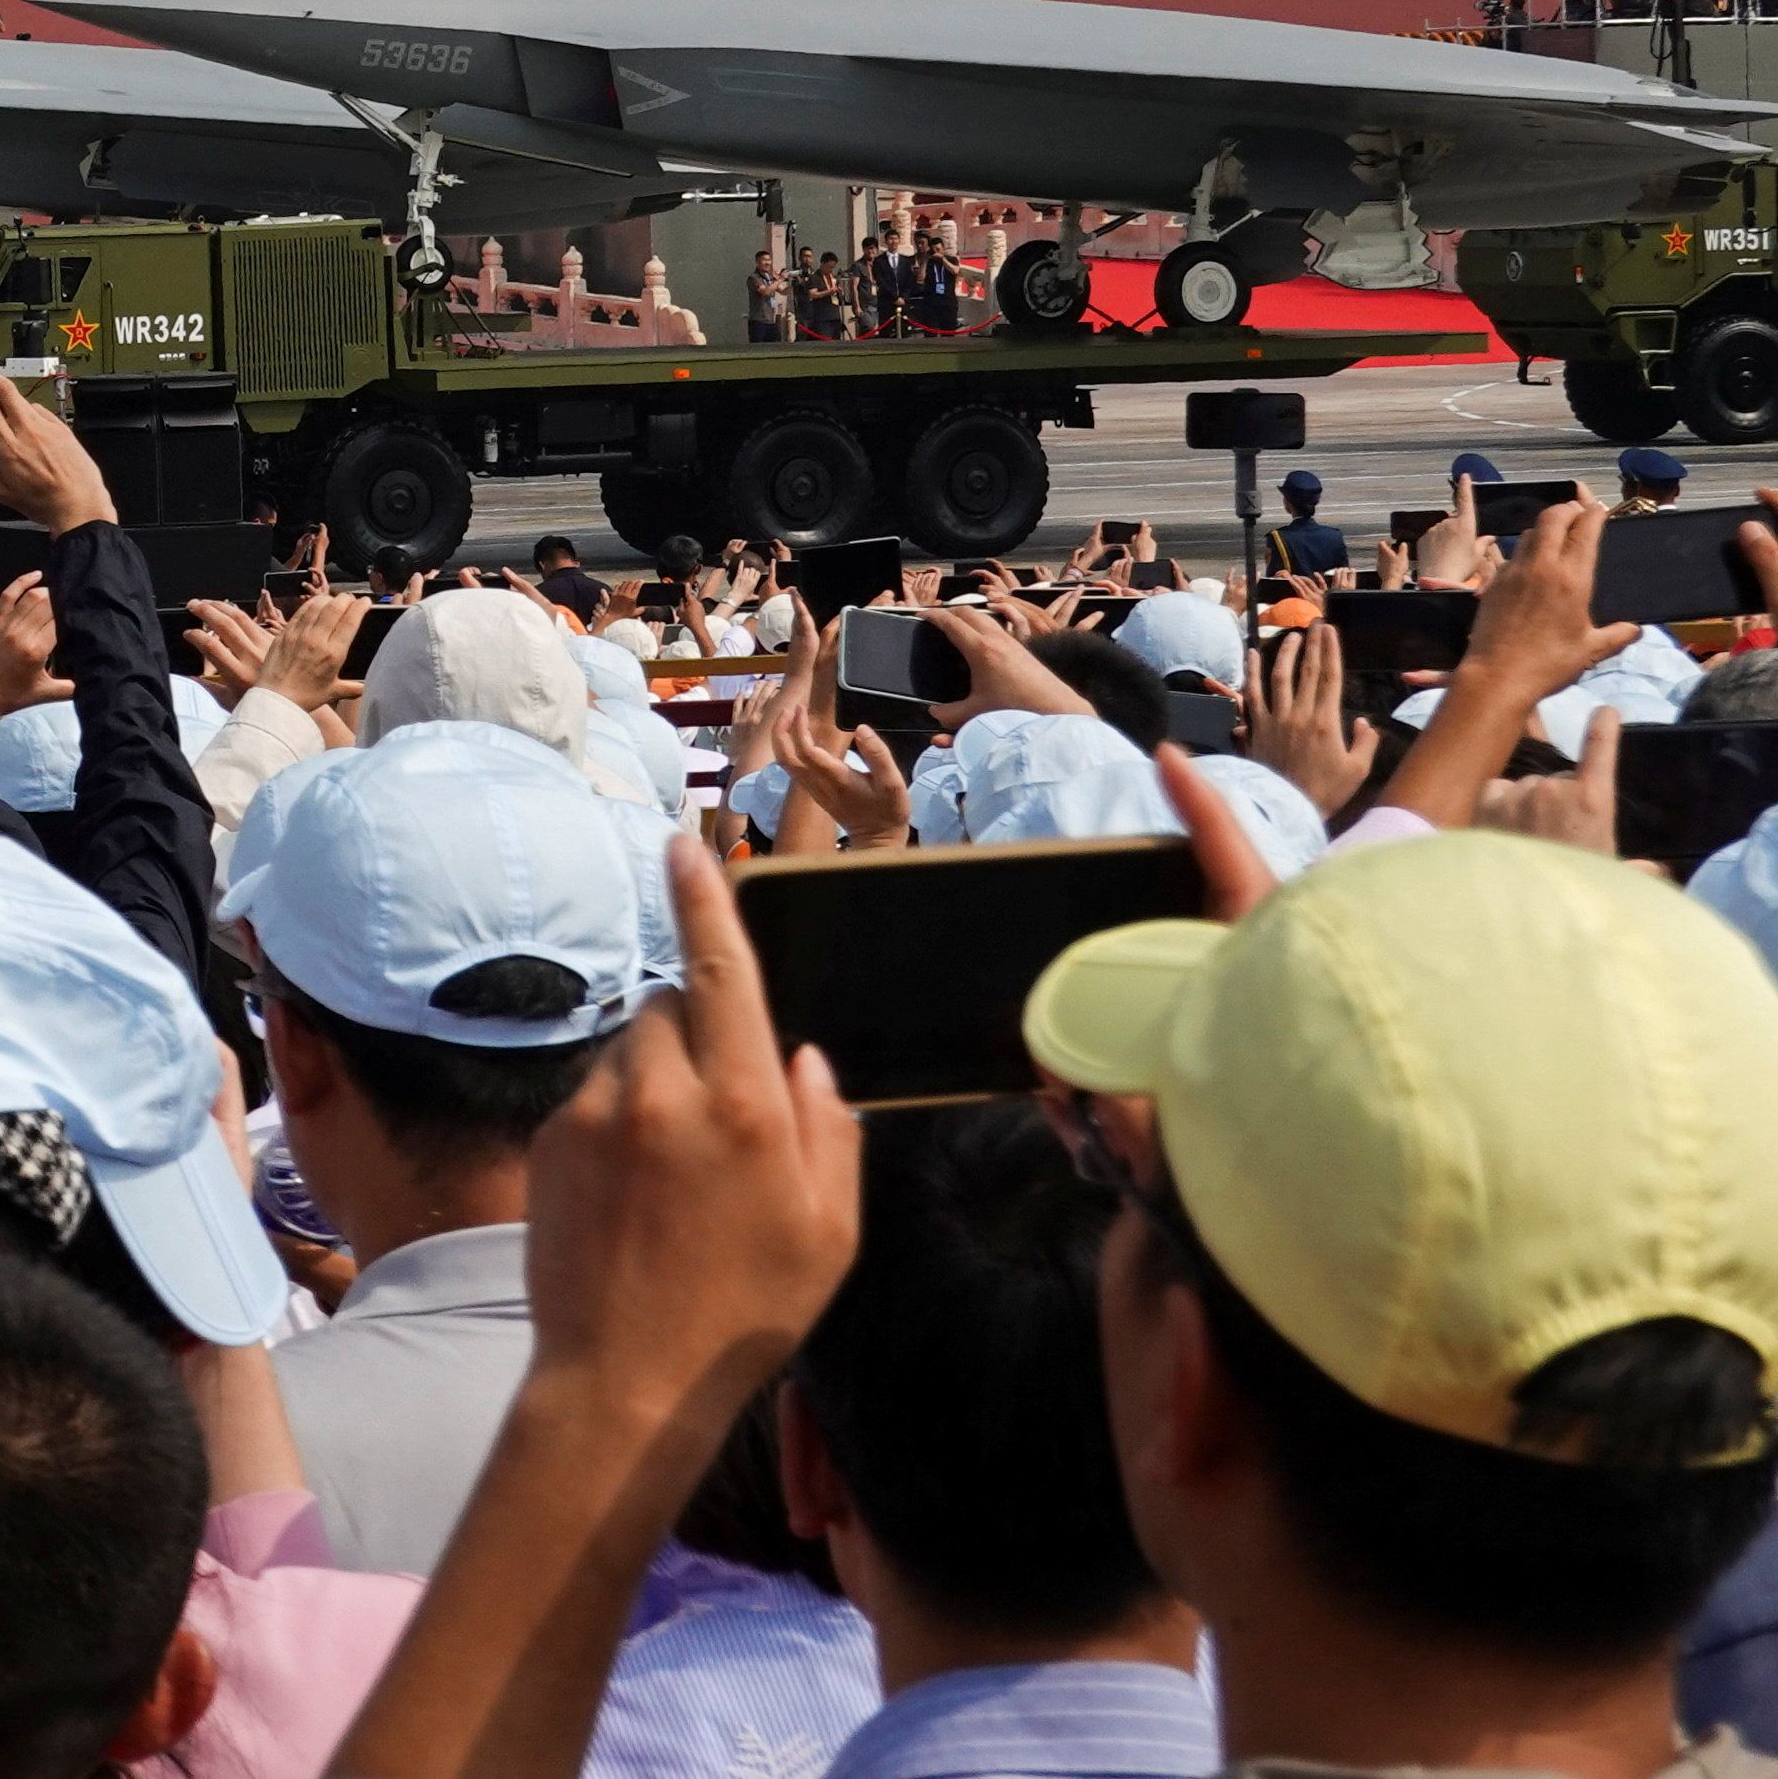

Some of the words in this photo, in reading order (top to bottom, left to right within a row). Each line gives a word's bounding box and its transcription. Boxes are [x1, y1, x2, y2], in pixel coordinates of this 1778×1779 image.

[360, 39, 472, 74] 53636
[1703, 227, 1770, 252] WR351
[114, 313, 205, 345] WR342
